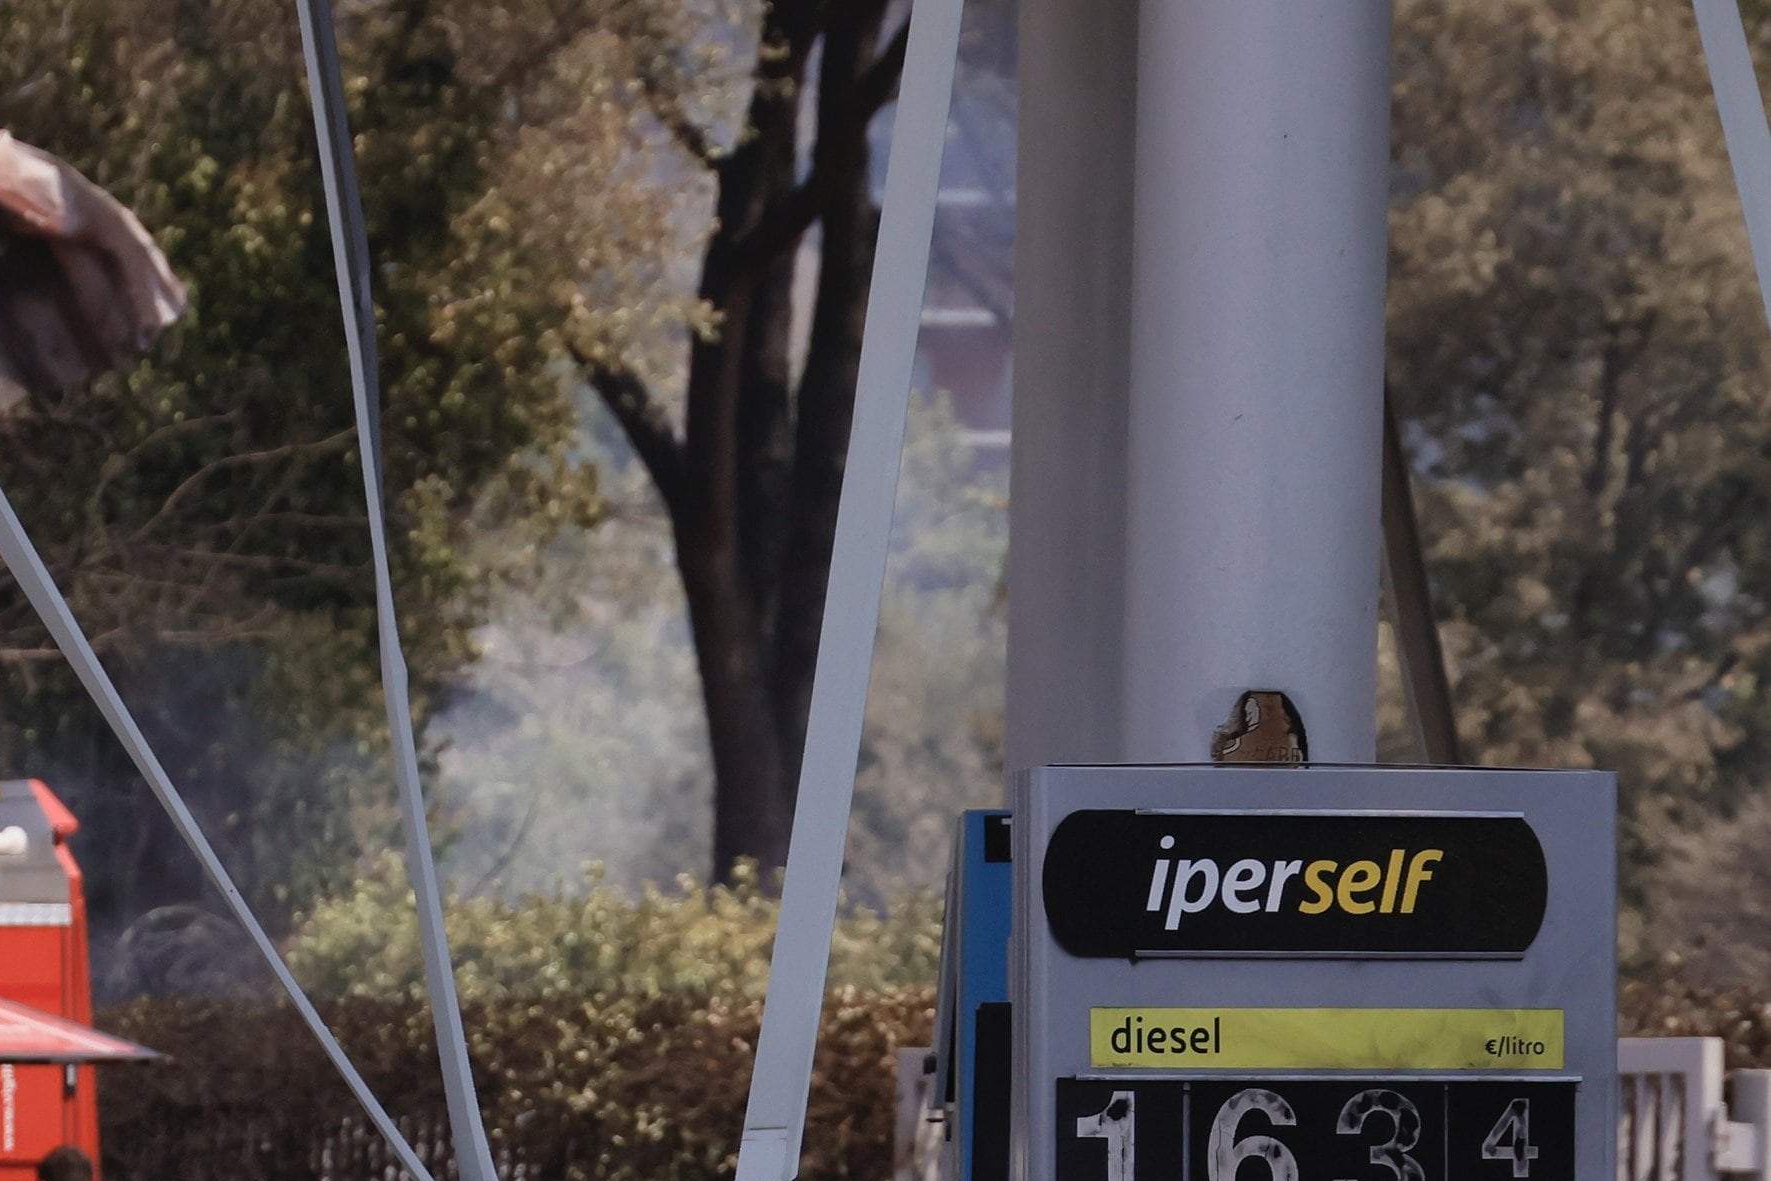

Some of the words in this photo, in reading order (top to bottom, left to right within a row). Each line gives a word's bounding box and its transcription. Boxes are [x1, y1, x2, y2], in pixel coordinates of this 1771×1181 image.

[1146, 834, 1444, 931] iperself
[1110, 1016, 1221, 1054] diesel
[1484, 1034, 1545, 1057] €/litro
